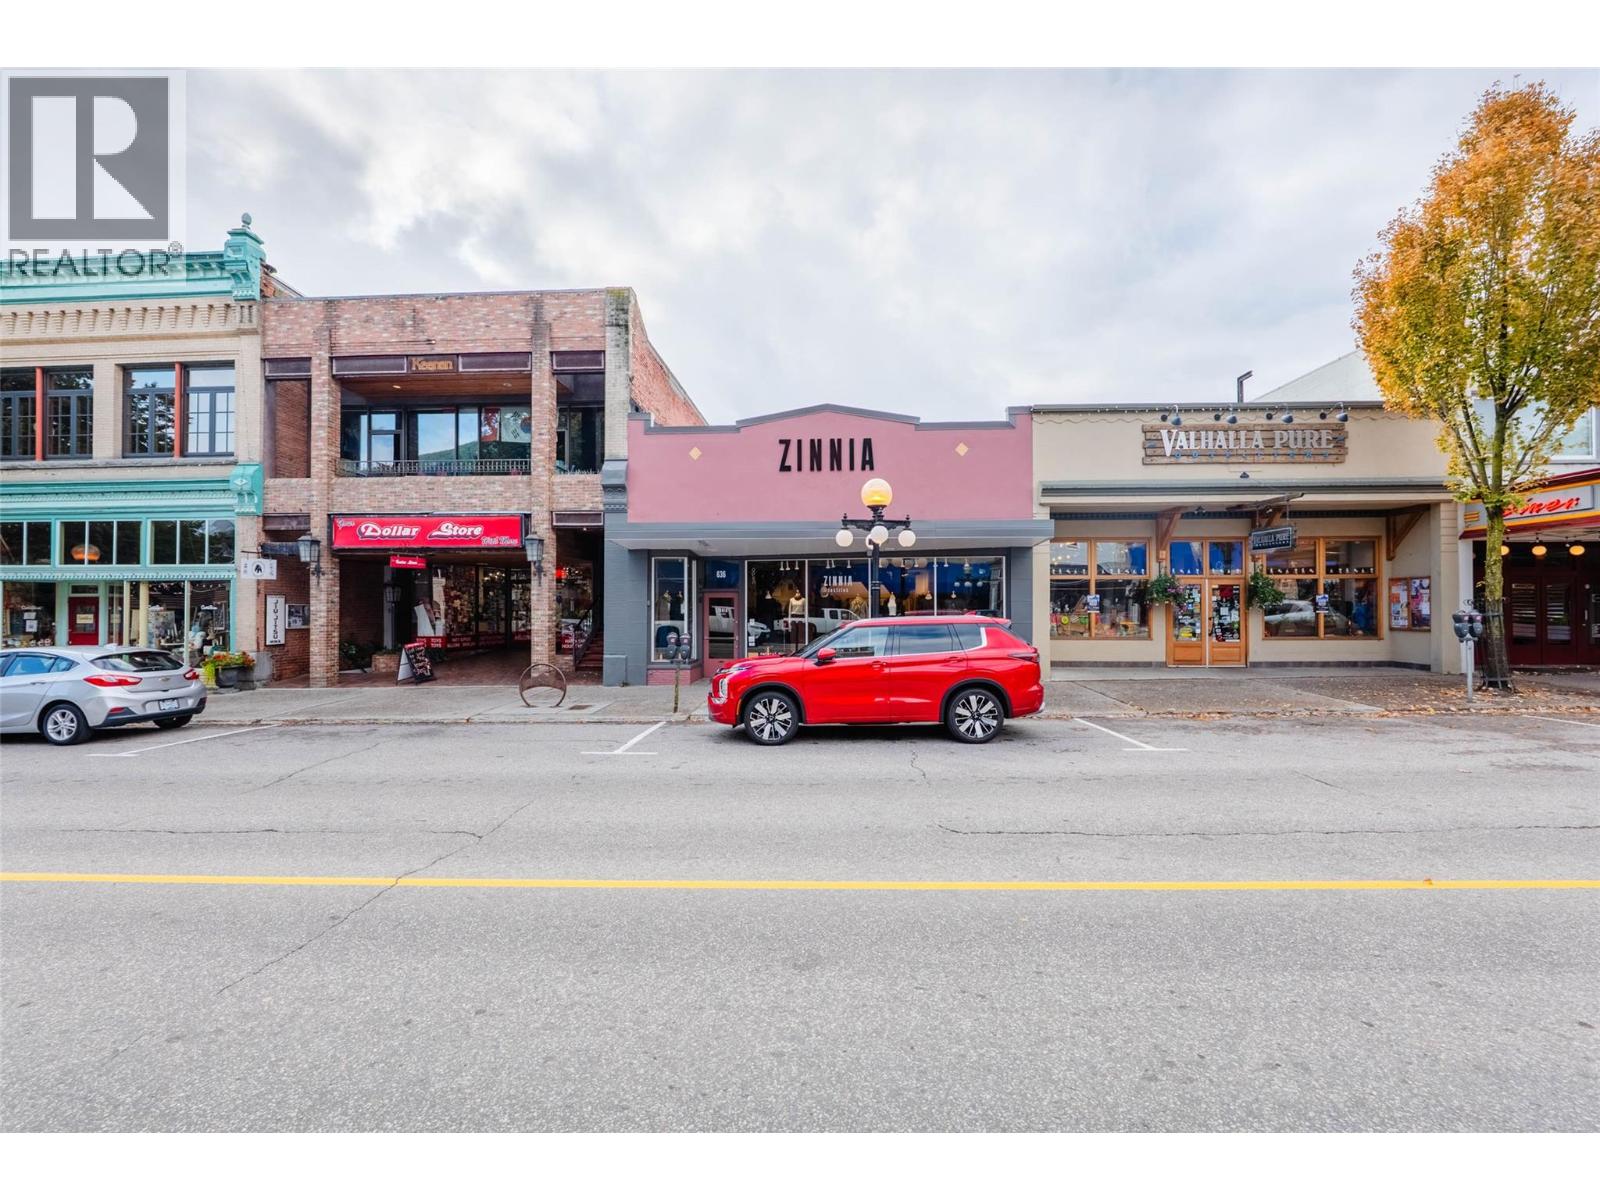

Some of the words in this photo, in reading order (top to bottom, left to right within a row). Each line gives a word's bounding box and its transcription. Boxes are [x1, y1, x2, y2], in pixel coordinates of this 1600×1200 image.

[1160, 430, 1264, 457] VALHALLA
[1273, 430, 1334, 449] PURE
[778, 438, 875, 472] ZINNIA
[1503, 497, 1581, 517] iner
[357, 522, 421, 540] Dollar
[427, 521, 484, 540] Store
[823, 575, 853, 587] ZINNIA
